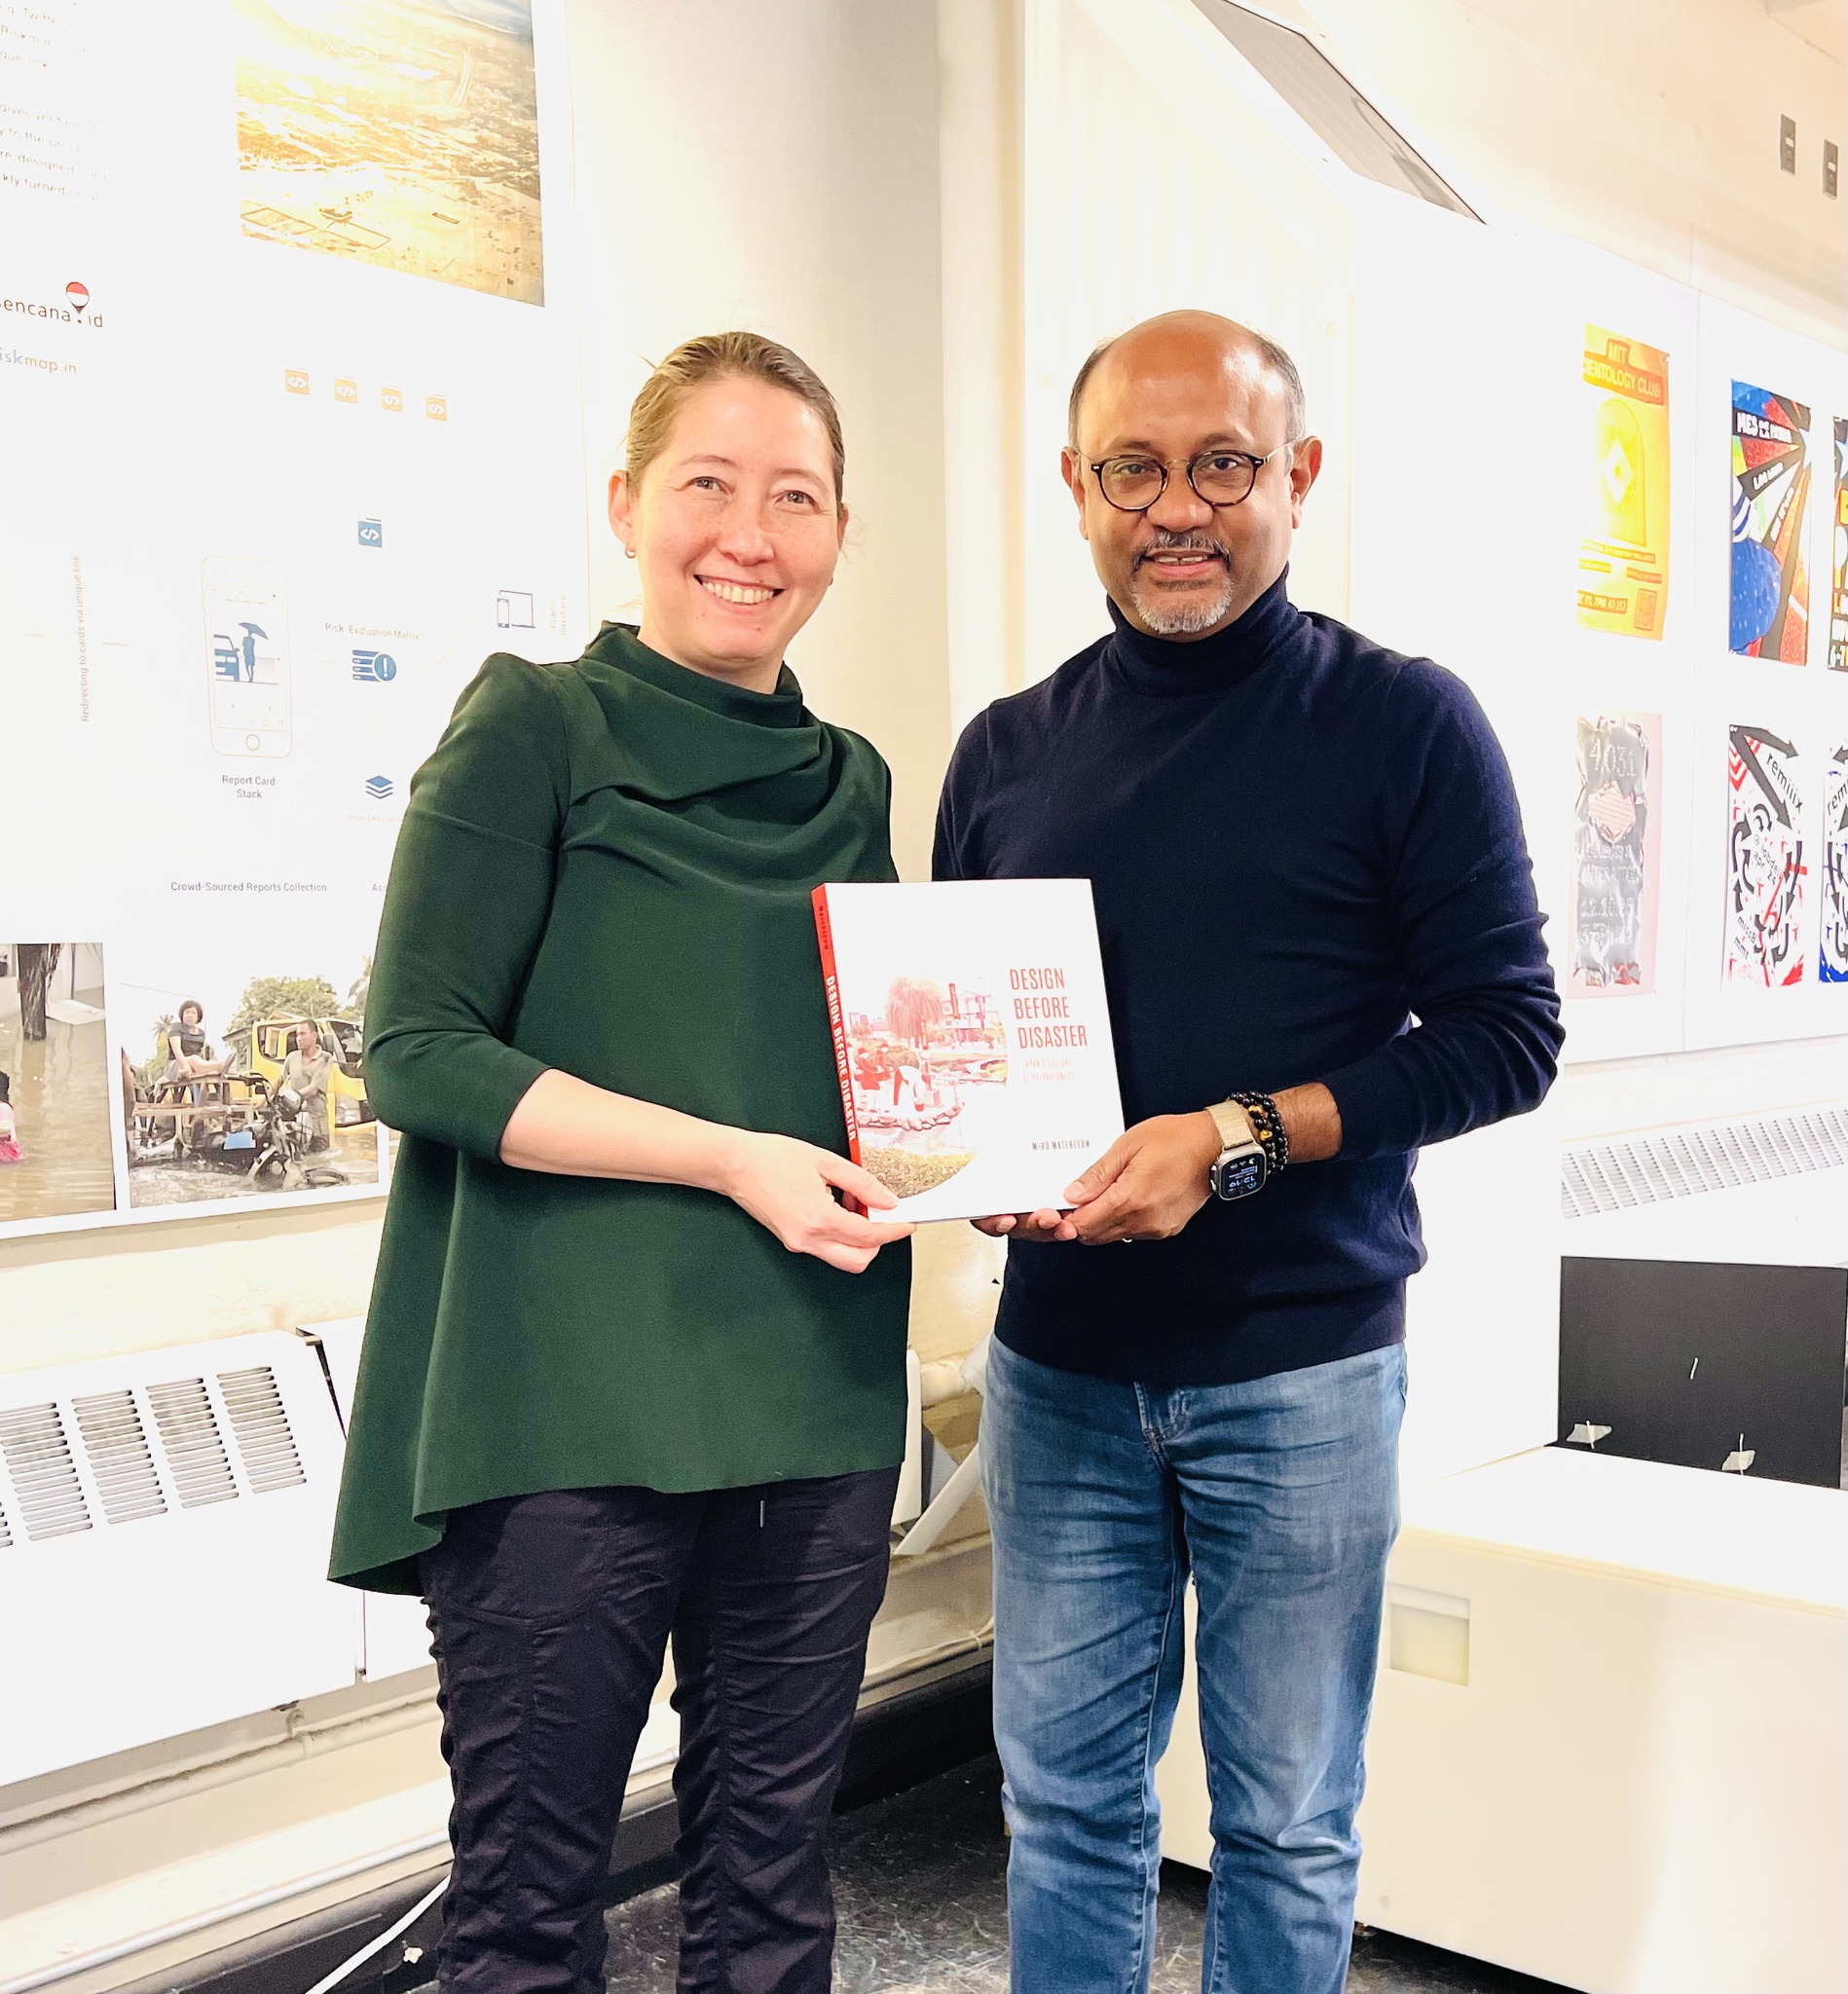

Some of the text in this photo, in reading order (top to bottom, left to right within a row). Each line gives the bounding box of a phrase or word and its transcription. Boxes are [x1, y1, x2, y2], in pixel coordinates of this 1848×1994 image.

[22, 7, 60, 24] Twitte
[24, 130, 44, 143] the
[18, 154, 75, 175] designed
[24, 178, 65, 196] turned
[0, 299, 103, 328] encana.id
[1608, 342, 1629, 365] MIT
[1638, 377, 1662, 398] CLUB
[71, 556, 80, 572] link
[73, 575, 83, 608] unique
[77, 627, 86, 653] cards
[324, 622, 420, 640] Risk Evaluation Matrix
[79, 655, 87, 665] to
[80, 668, 91, 722] Redirecting
[222, 774, 276, 787] Report Card
[1766, 753, 1803, 814] remiiix
[236, 789, 263, 799] Stack
[170, 880, 328, 893] Crowd-Sourced Reports Collection
[1009, 968, 1065, 990] DESIGN
[1014, 996, 1070, 1019] BEFORE
[1017, 1025, 1089, 1050] DISASTER
[826, 975, 856, 1142] DESIGN BEFORE DISASTER
